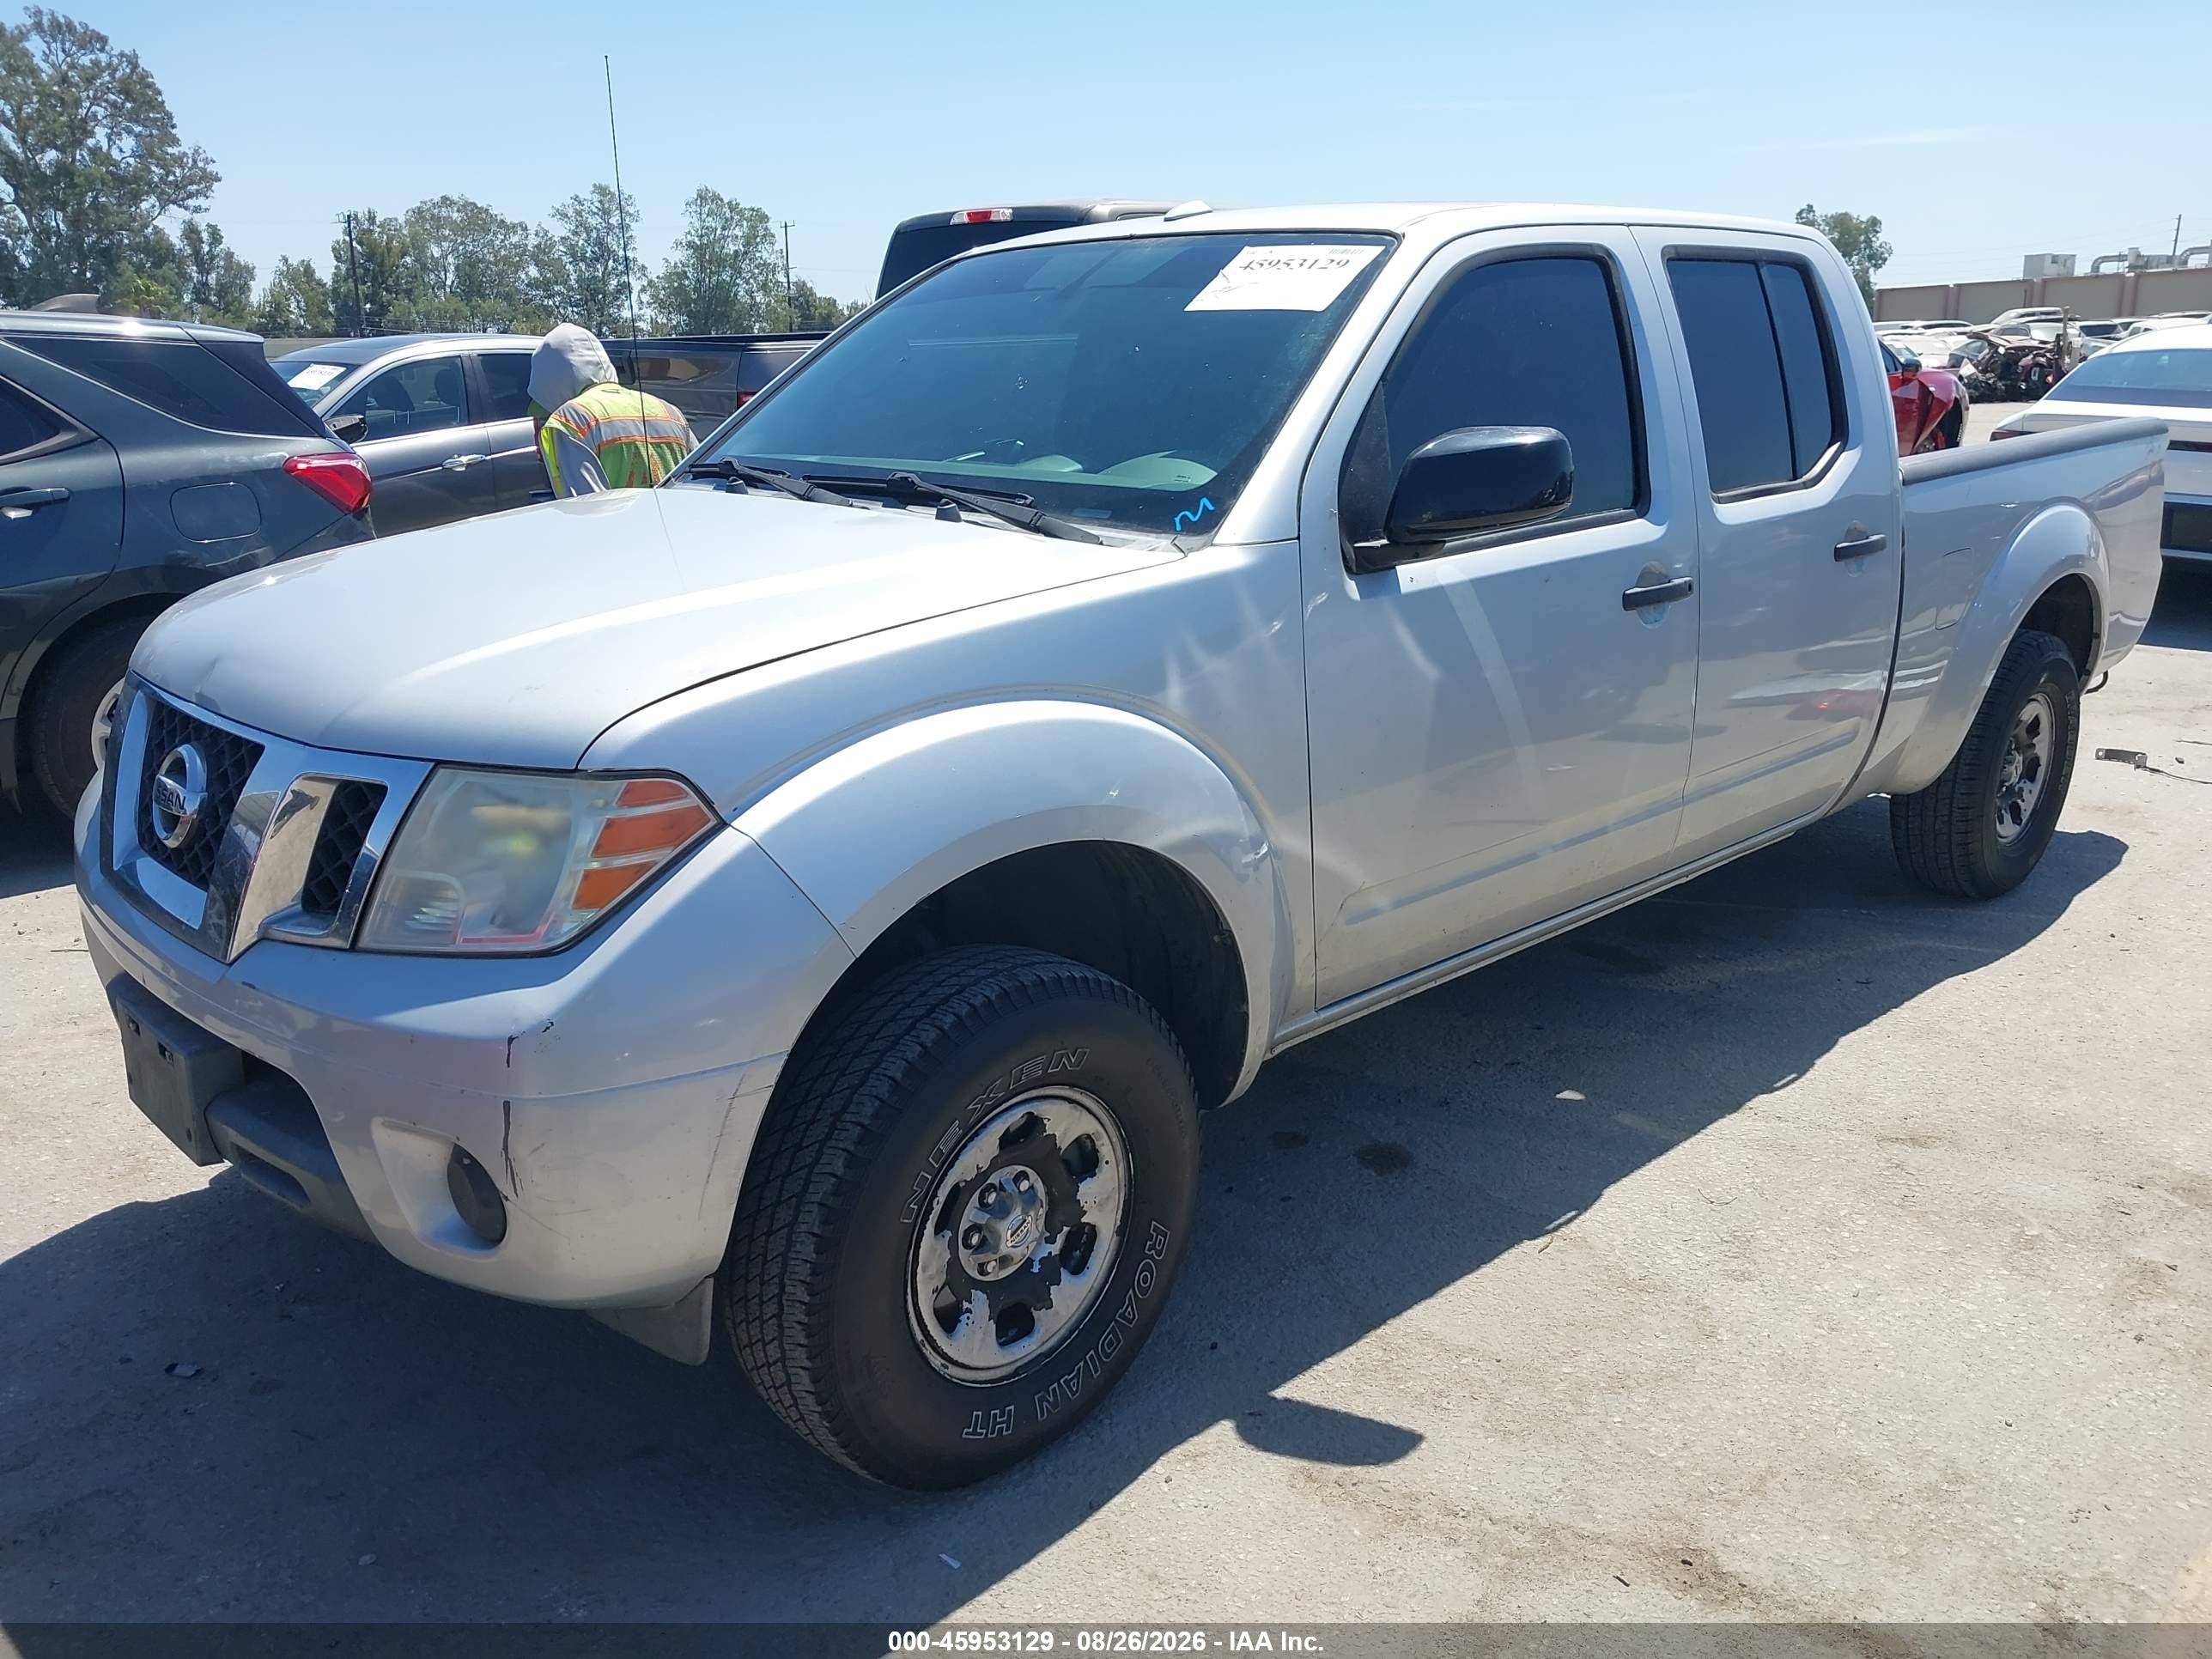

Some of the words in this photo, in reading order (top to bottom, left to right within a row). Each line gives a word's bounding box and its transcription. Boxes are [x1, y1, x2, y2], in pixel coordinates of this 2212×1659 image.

[1238, 258, 1350, 270] 45953129
[901, 1048, 1090, 1224] NEXEN
[1036, 1220, 1170, 1421] ROADIAN
[961, 1405, 1015, 1439] HT
